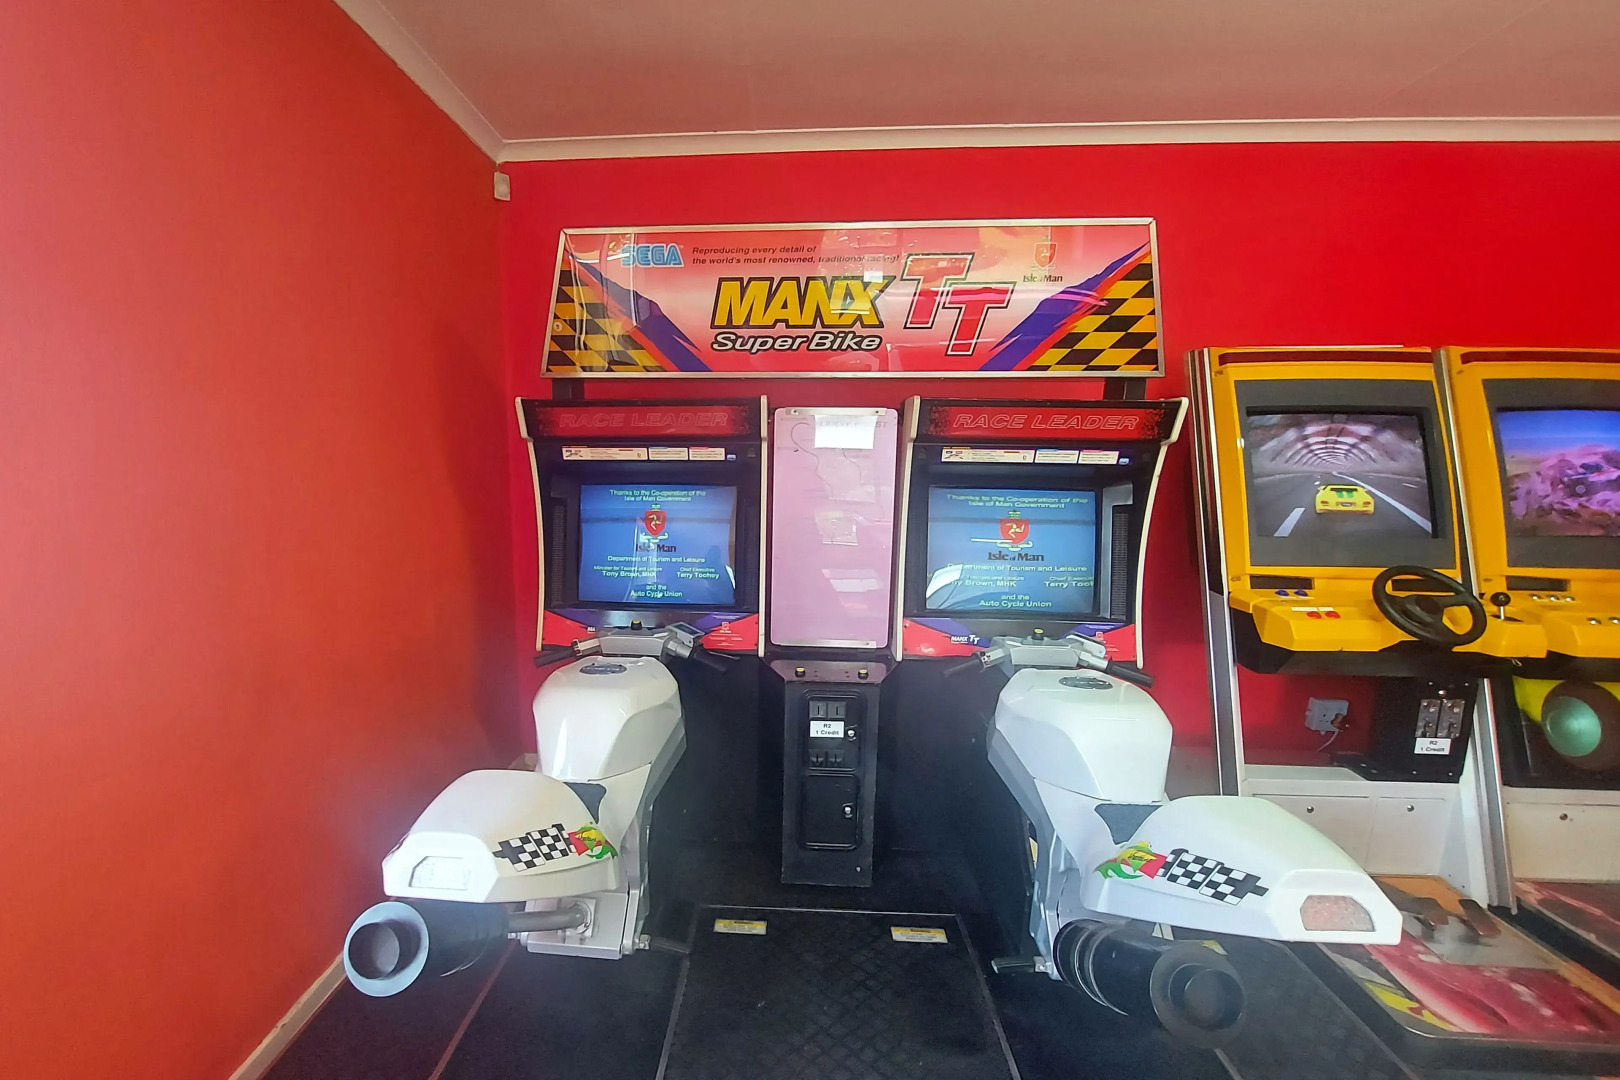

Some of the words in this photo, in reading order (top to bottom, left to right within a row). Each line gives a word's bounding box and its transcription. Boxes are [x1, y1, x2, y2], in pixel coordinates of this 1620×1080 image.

[621, 244, 684, 267] SEGA
[692, 246, 750, 255] Reproducing
[752, 246, 777, 255] every
[768, 256, 816, 264] renowned,
[710, 275, 897, 330] MANX
[900, 252, 1017, 356] TT
[559, 413, 626, 428] RACE
[631, 412, 729, 427] LEADER
[953, 413, 1027, 428] RACE
[1030, 414, 1140, 430] LEADER
[657, 544, 676, 552] Man
[987, 550, 1008, 560] Isle
[1017, 552, 1044, 560] Man
[676, 571, 692, 580] Terry
[969, 634, 981, 645] TT
